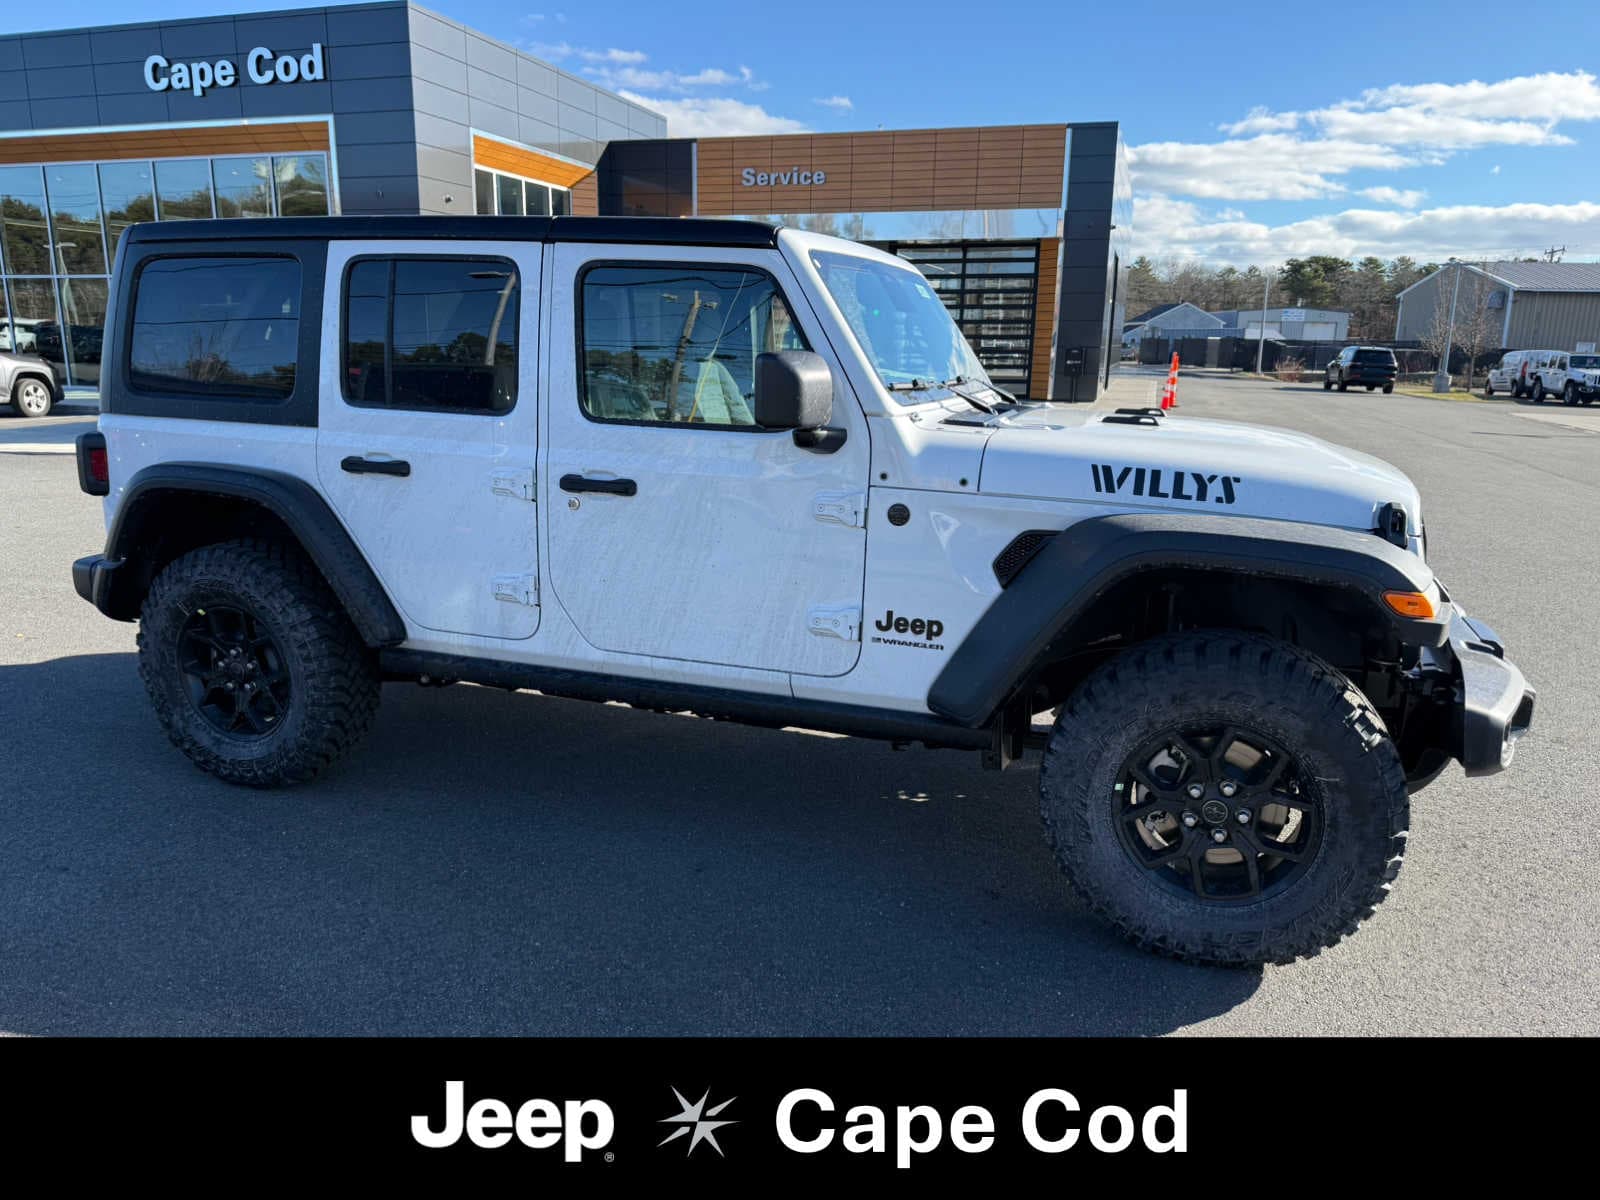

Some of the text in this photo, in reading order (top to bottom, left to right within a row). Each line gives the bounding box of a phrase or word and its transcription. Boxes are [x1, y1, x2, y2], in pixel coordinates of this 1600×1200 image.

[144, 42, 325, 97] Cape Cod
[741, 165, 826, 187] Service
[1091, 463, 1241, 504] WILLYS
[875, 610, 944, 641] Jeep
[882, 637, 944, 651] WRANGLER
